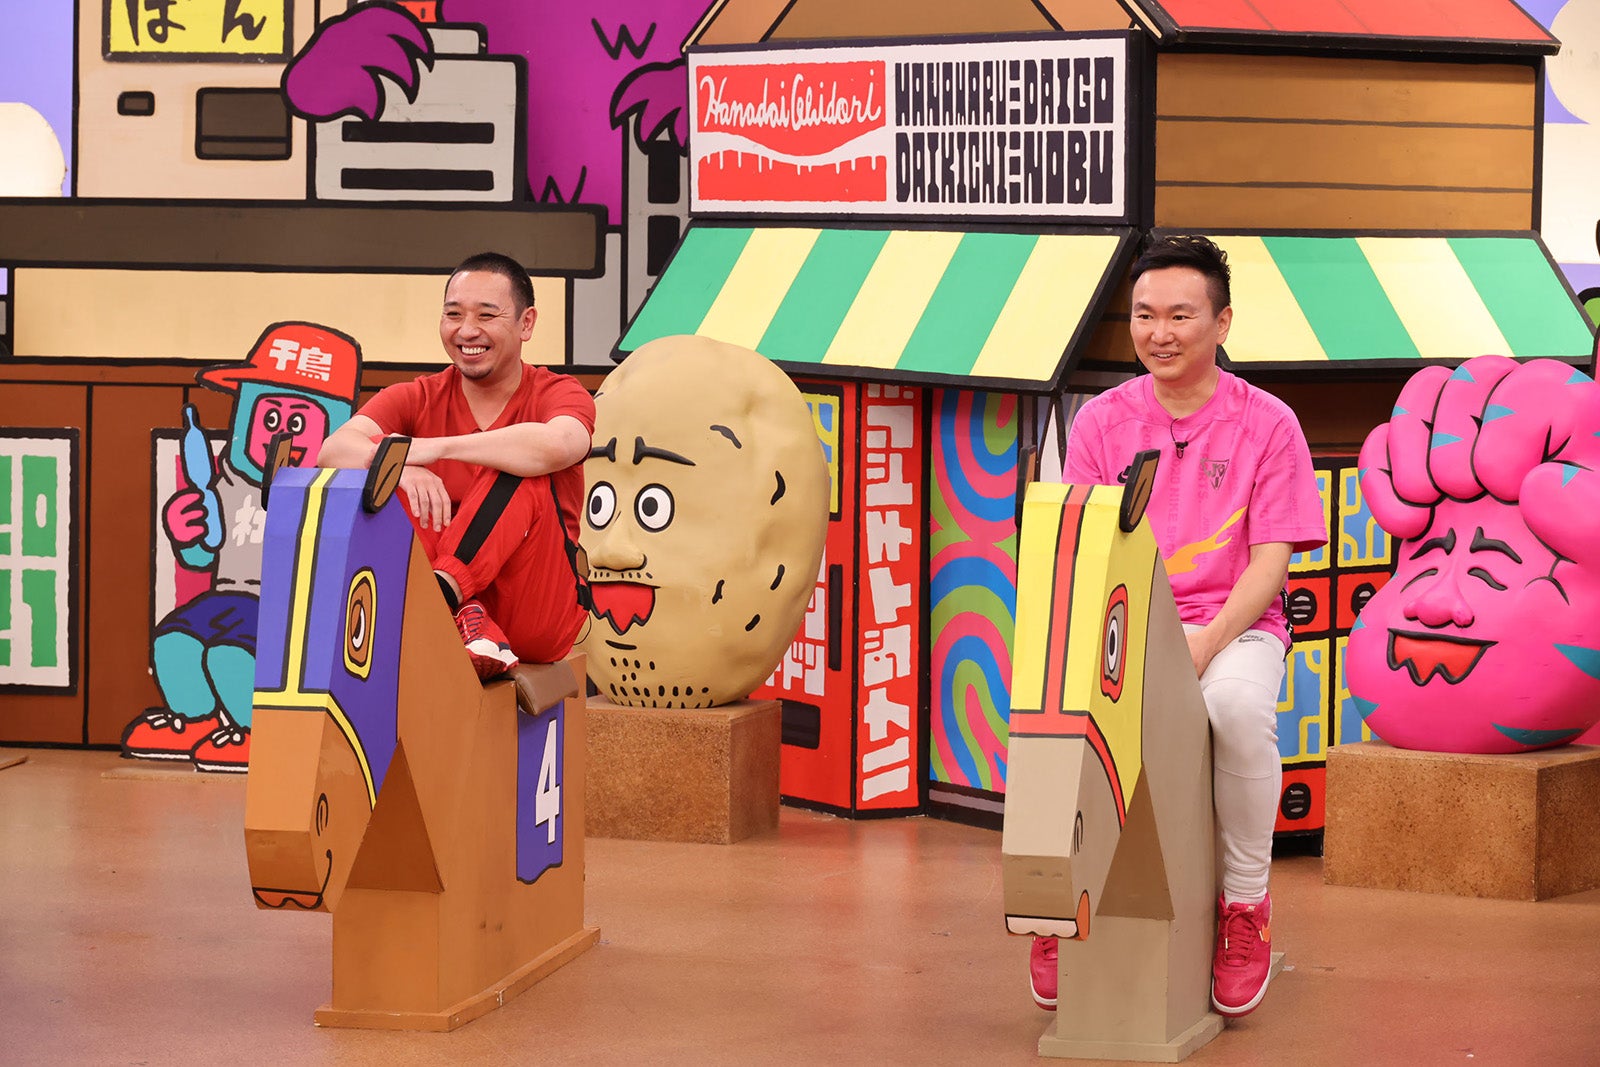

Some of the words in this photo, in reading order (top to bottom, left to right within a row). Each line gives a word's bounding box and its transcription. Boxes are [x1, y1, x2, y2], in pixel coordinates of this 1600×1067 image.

[700, 75, 789, 128] Hanadai
[895, 60, 1007, 126] HANAMARU
[1024, 57, 1114, 124] DAIGO
[895, 131, 1007, 203] DAIKICHI
[1024, 130, 1114, 204] NOBU
[269, 338, 332, 382] 千鳥
[535, 718, 560, 844] 4
